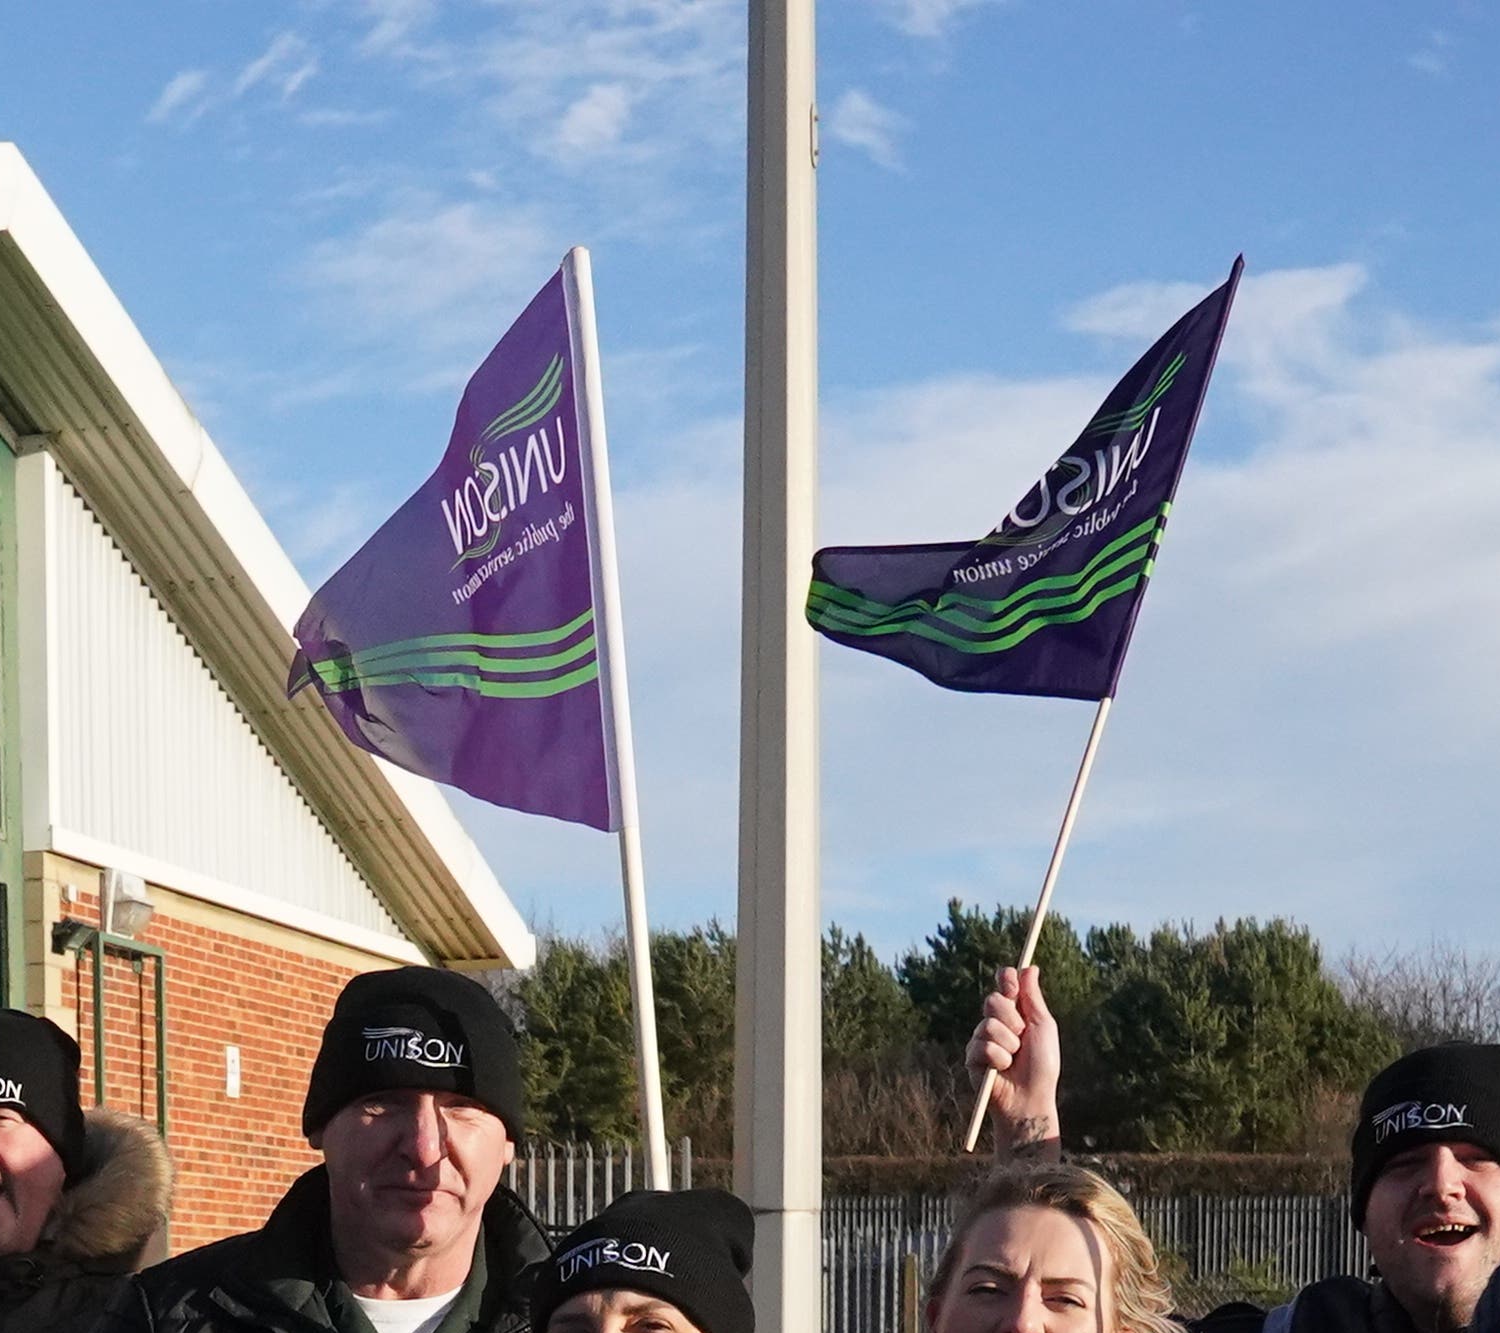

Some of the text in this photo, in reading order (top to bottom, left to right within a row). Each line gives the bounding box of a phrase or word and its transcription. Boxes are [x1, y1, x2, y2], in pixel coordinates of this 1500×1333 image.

[365, 1033, 463, 1066] UNISON
[1374, 1103, 1468, 1144] UNISON
[559, 1240, 670, 1283] UNISON
